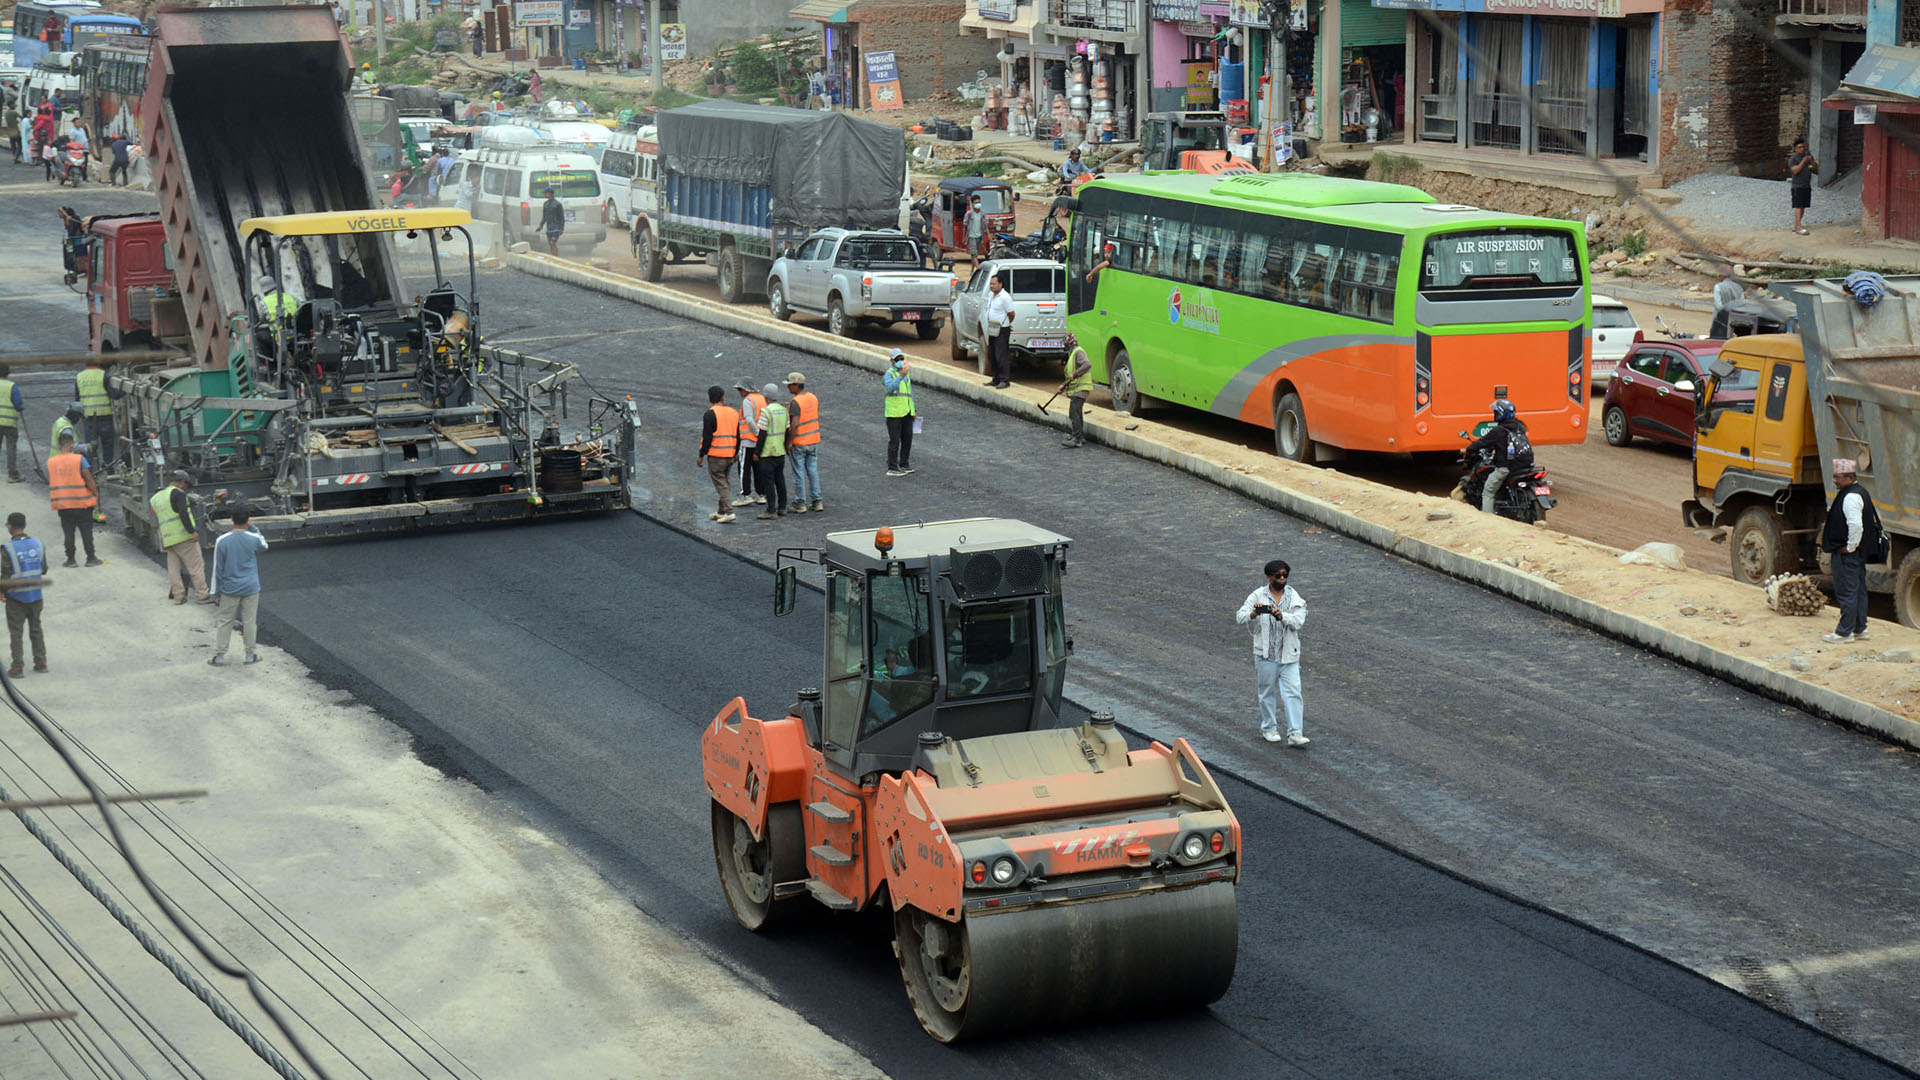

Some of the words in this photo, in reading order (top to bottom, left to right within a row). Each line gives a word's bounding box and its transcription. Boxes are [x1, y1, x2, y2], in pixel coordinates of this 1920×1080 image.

[347, 216, 407, 232] VÖGELE
[1456, 241, 1475, 253] AIR
[1478, 239, 1545, 253] SUSPENSION
[721, 751, 741, 770] HAMM
[930, 848, 944, 869] 128
[1076, 846, 1123, 863] HAMM
